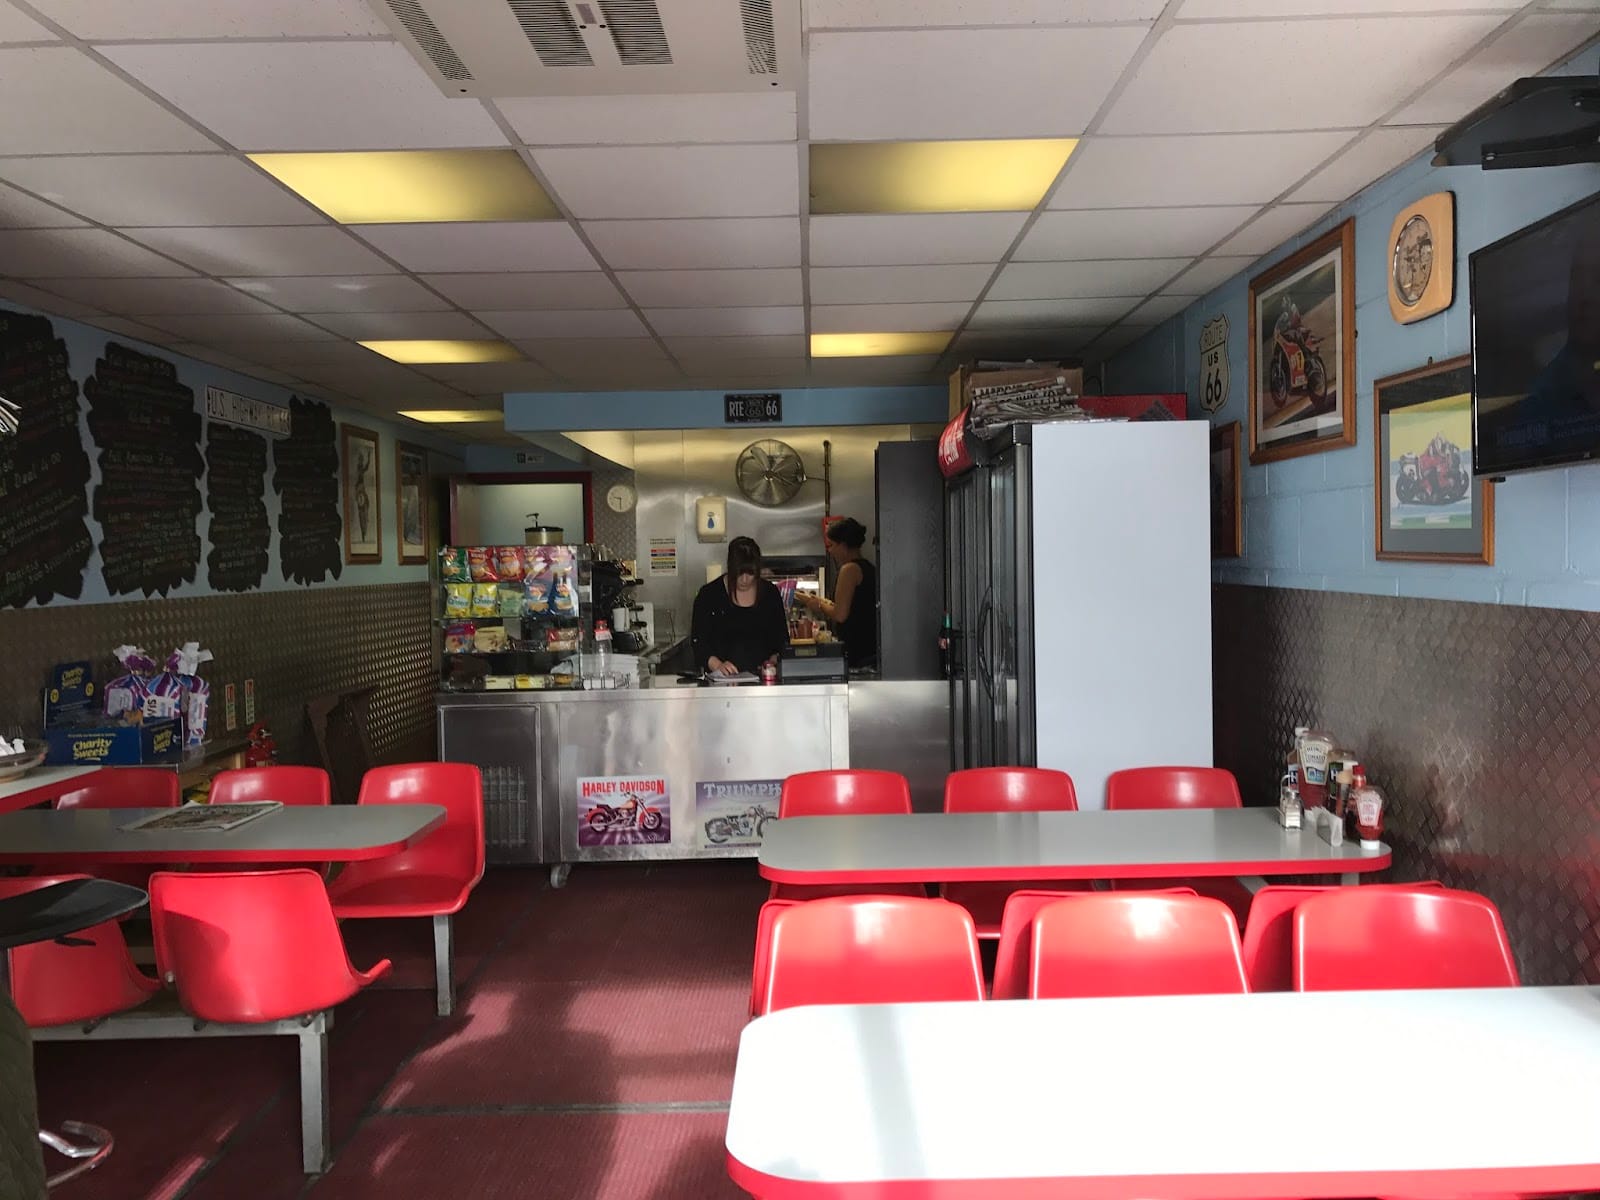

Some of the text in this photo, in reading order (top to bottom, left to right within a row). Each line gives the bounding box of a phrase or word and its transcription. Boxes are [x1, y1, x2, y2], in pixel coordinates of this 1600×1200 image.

[1204, 324, 1223, 347] ROUTE
[1207, 351, 1219, 367] US
[1205, 368, 1222, 405] 66
[728, 401, 744, 416] RTE
[765, 400, 778, 416] 66
[72, 737, 113, 752] Charity
[73, 747, 109, 760] Sweets
[582, 779, 665, 797] HARLEY DAVIDSON
[703, 782, 782, 799] TRIUMPH
